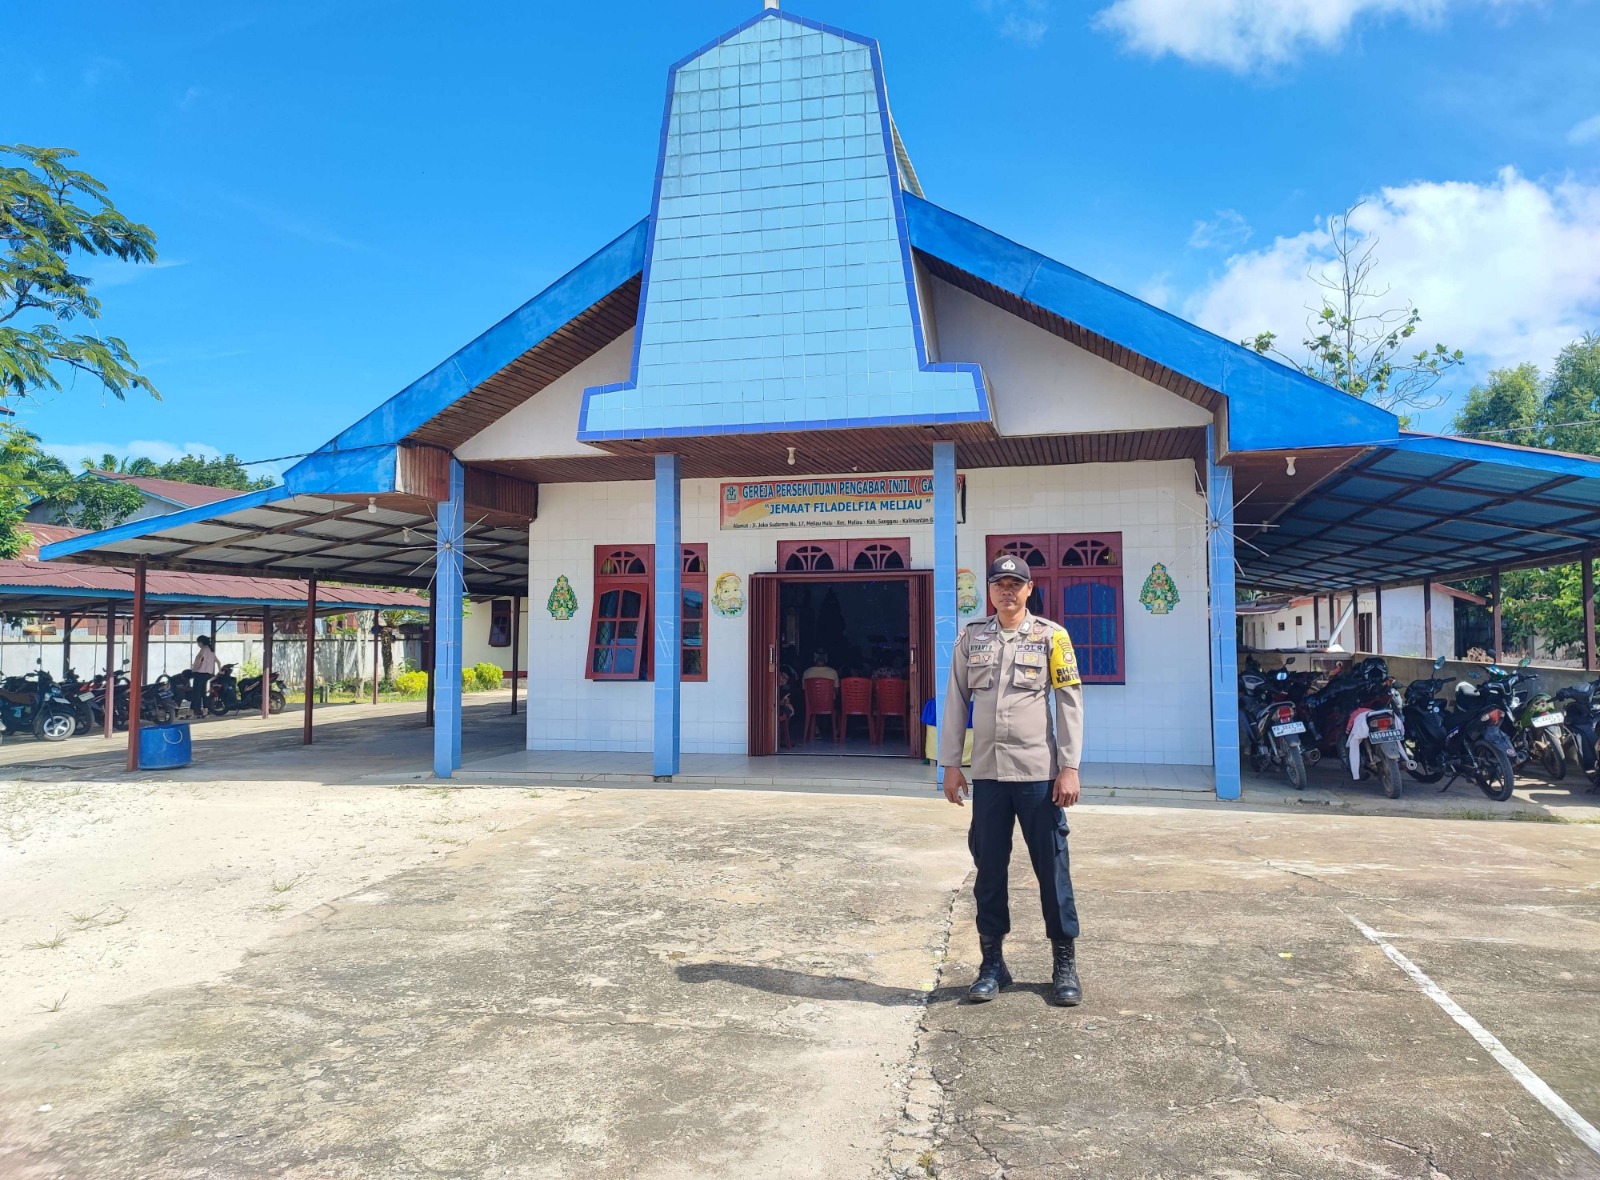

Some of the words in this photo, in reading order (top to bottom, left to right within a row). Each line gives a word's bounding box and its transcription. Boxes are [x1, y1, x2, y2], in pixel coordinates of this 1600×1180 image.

[742, 485, 774, 499] GEREJA
[776, 482, 837, 498] PERSEKUTUAN
[839, 480, 886, 495] PENGABAR
[888, 479, 912, 493] INJIL
[814, 501, 877, 513] FILADELFIA
[880, 500, 922, 511] MELIAU
[1017, 644, 1046, 652] POLRI
